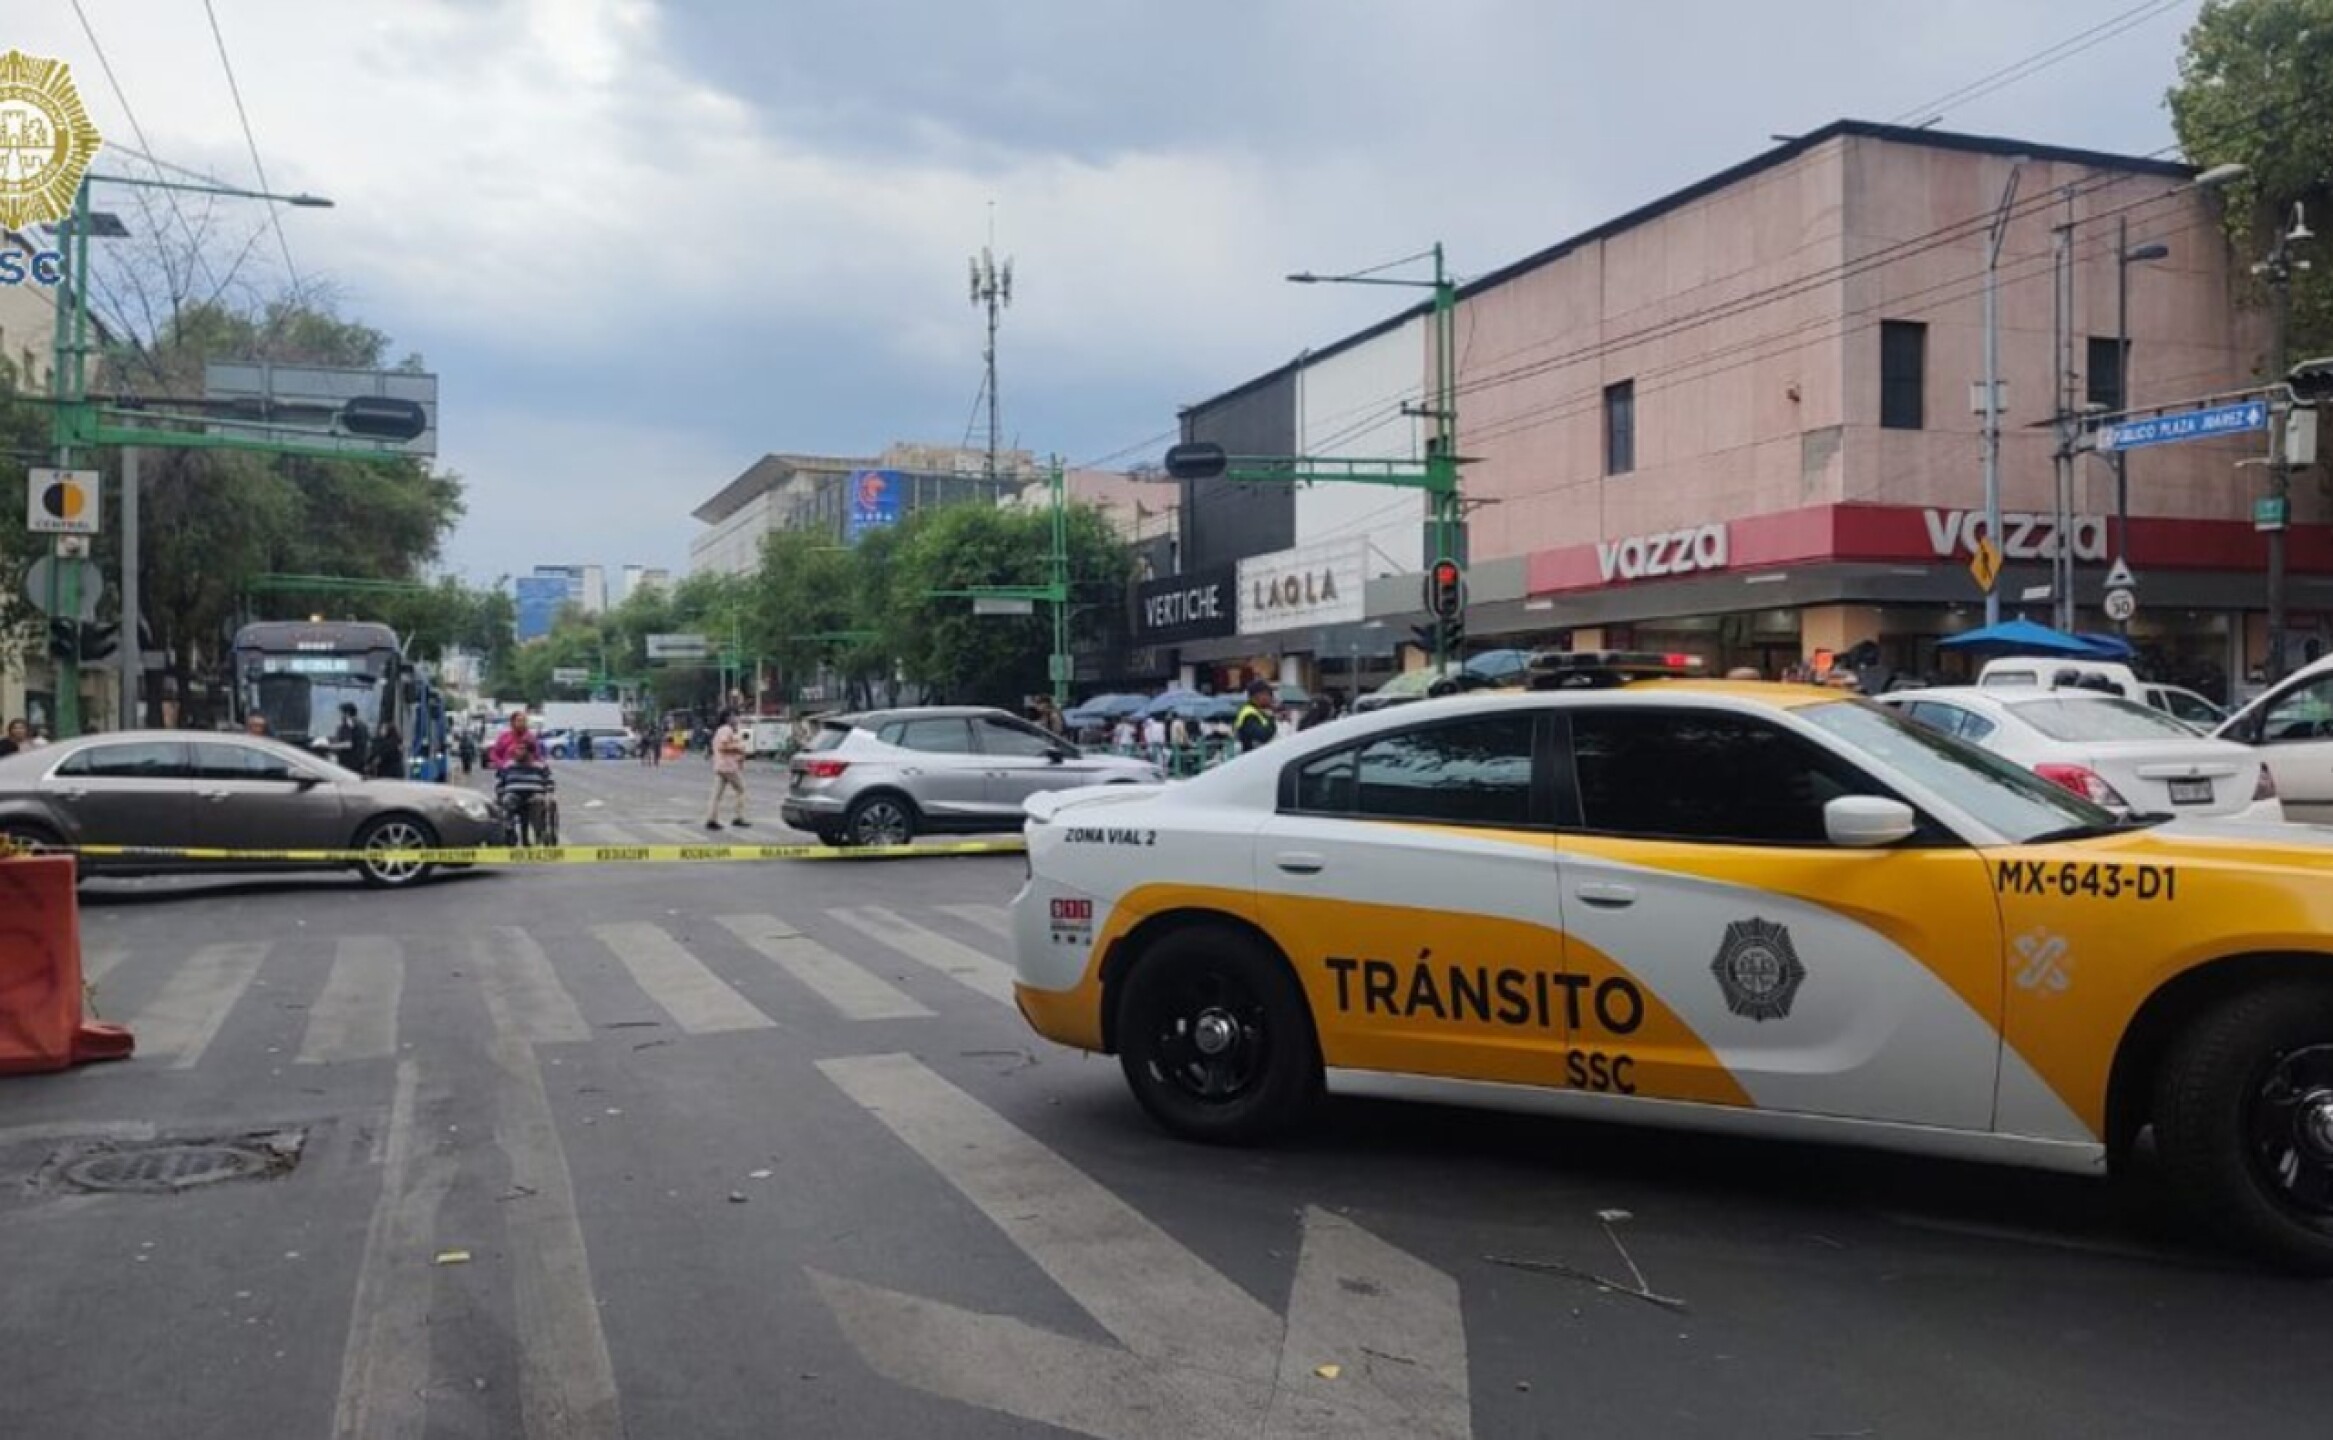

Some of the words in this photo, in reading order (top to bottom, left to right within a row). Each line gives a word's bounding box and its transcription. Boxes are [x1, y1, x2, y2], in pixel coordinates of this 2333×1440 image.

[1596, 523, 1729, 582] vazza
[1923, 508, 2108, 561] vazza
[1064, 827, 1104, 843] ZONA
[1108, 828, 1141, 845] VIAL
[1145, 830, 1157, 846] 2
[1996, 859, 2177, 902] MX-643-D1
[1324, 948, 1646, 1036] TRÁNSITO
[1566, 1049, 1637, 1095] SSC
